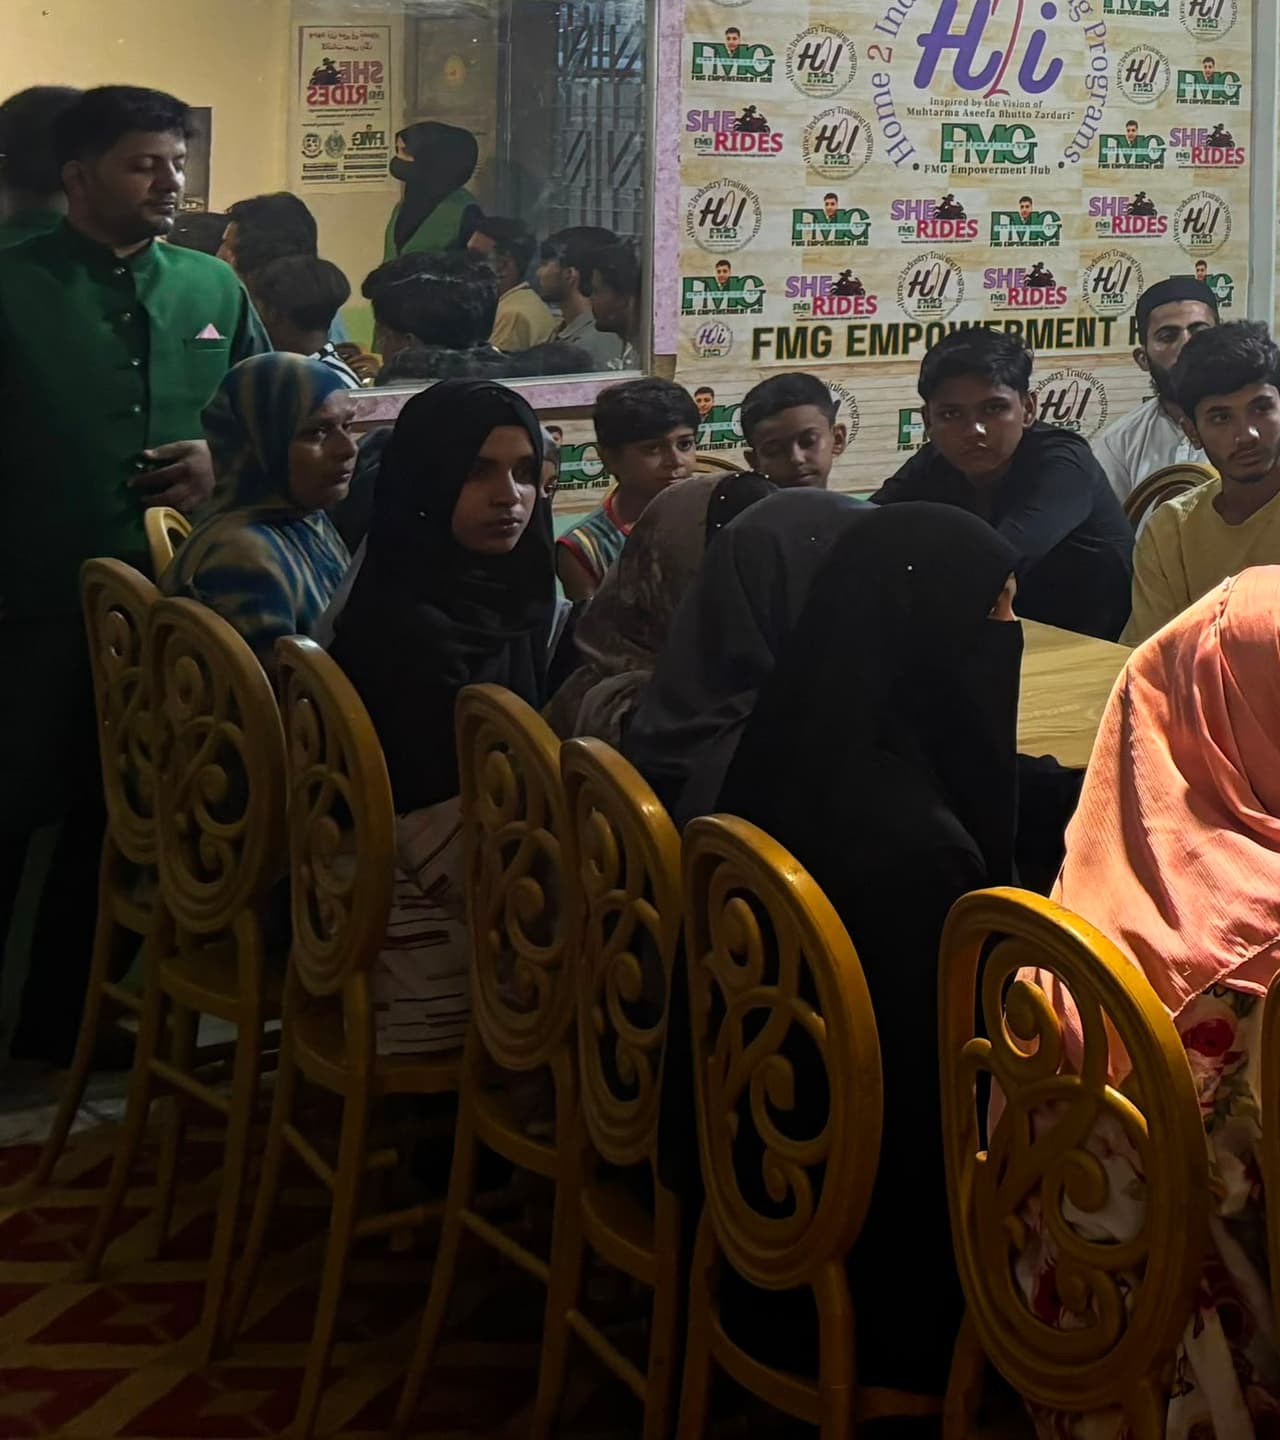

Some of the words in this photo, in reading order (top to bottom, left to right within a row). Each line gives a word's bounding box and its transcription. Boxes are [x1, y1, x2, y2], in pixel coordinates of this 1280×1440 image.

[867, 44, 892, 64] 2
[1063, 19, 1109, 164] Programs
[686, 110, 736, 132] SHE
[871, 72, 917, 168] Home
[714, 133, 783, 152] RIDES
[940, 122, 1038, 165] FMG
[751, 324, 832, 361] FMG
